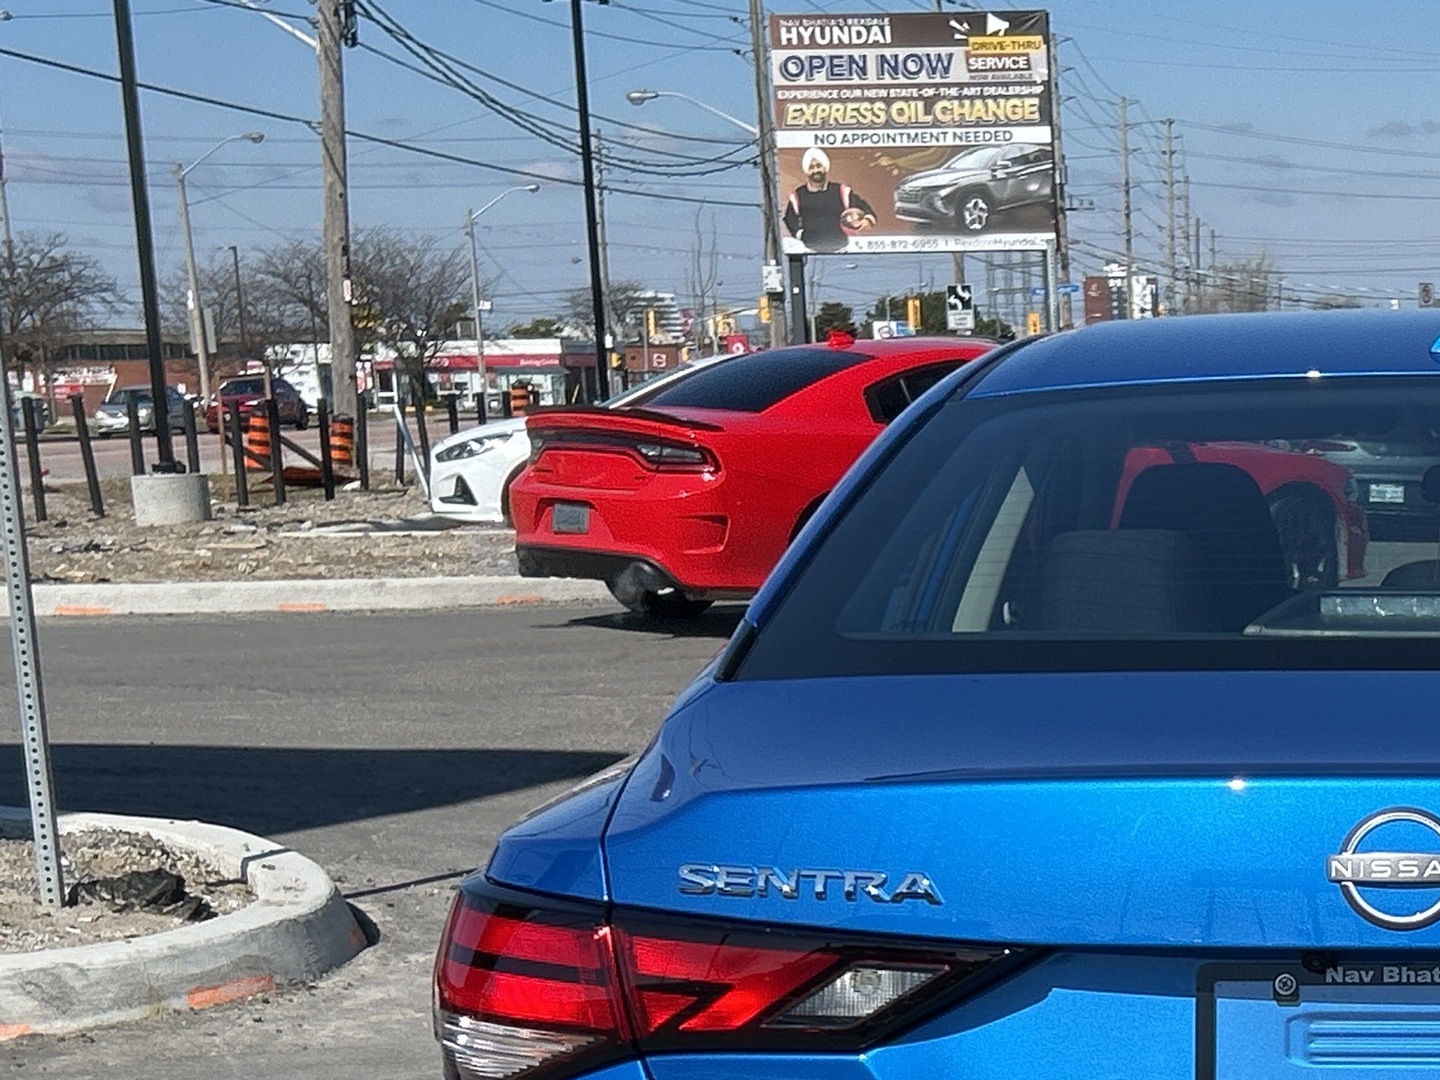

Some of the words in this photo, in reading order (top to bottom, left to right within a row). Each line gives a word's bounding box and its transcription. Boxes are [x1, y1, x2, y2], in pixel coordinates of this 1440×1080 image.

[780, 26, 892, 45] HYUNDAI
[971, 40, 1042, 51] DRIVE-THRU
[779, 54, 868, 82] OPEN
[877, 51, 954, 80] NOW
[968, 56, 1029, 70] SERVICE
[777, 90, 839, 99] EXPERIENCE
[840, 90, 862, 98] OUR
[864, 89, 888, 98] NEW
[889, 86, 982, 98] STATE-OF-THE-ART
[983, 85, 1044, 96] DEALERSHIP
[783, 101, 888, 128] EXPRESS
[889, 100, 933, 127] OIL
[932, 97, 1040, 125] CHANGE
[814, 133, 837, 145] NO
[840, 131, 949, 144] APPOINTMENT
[953, 130, 1013, 143] NEEDED
[678, 864, 944, 905] SENTRA
[1325, 967, 1375, 984] Nav
